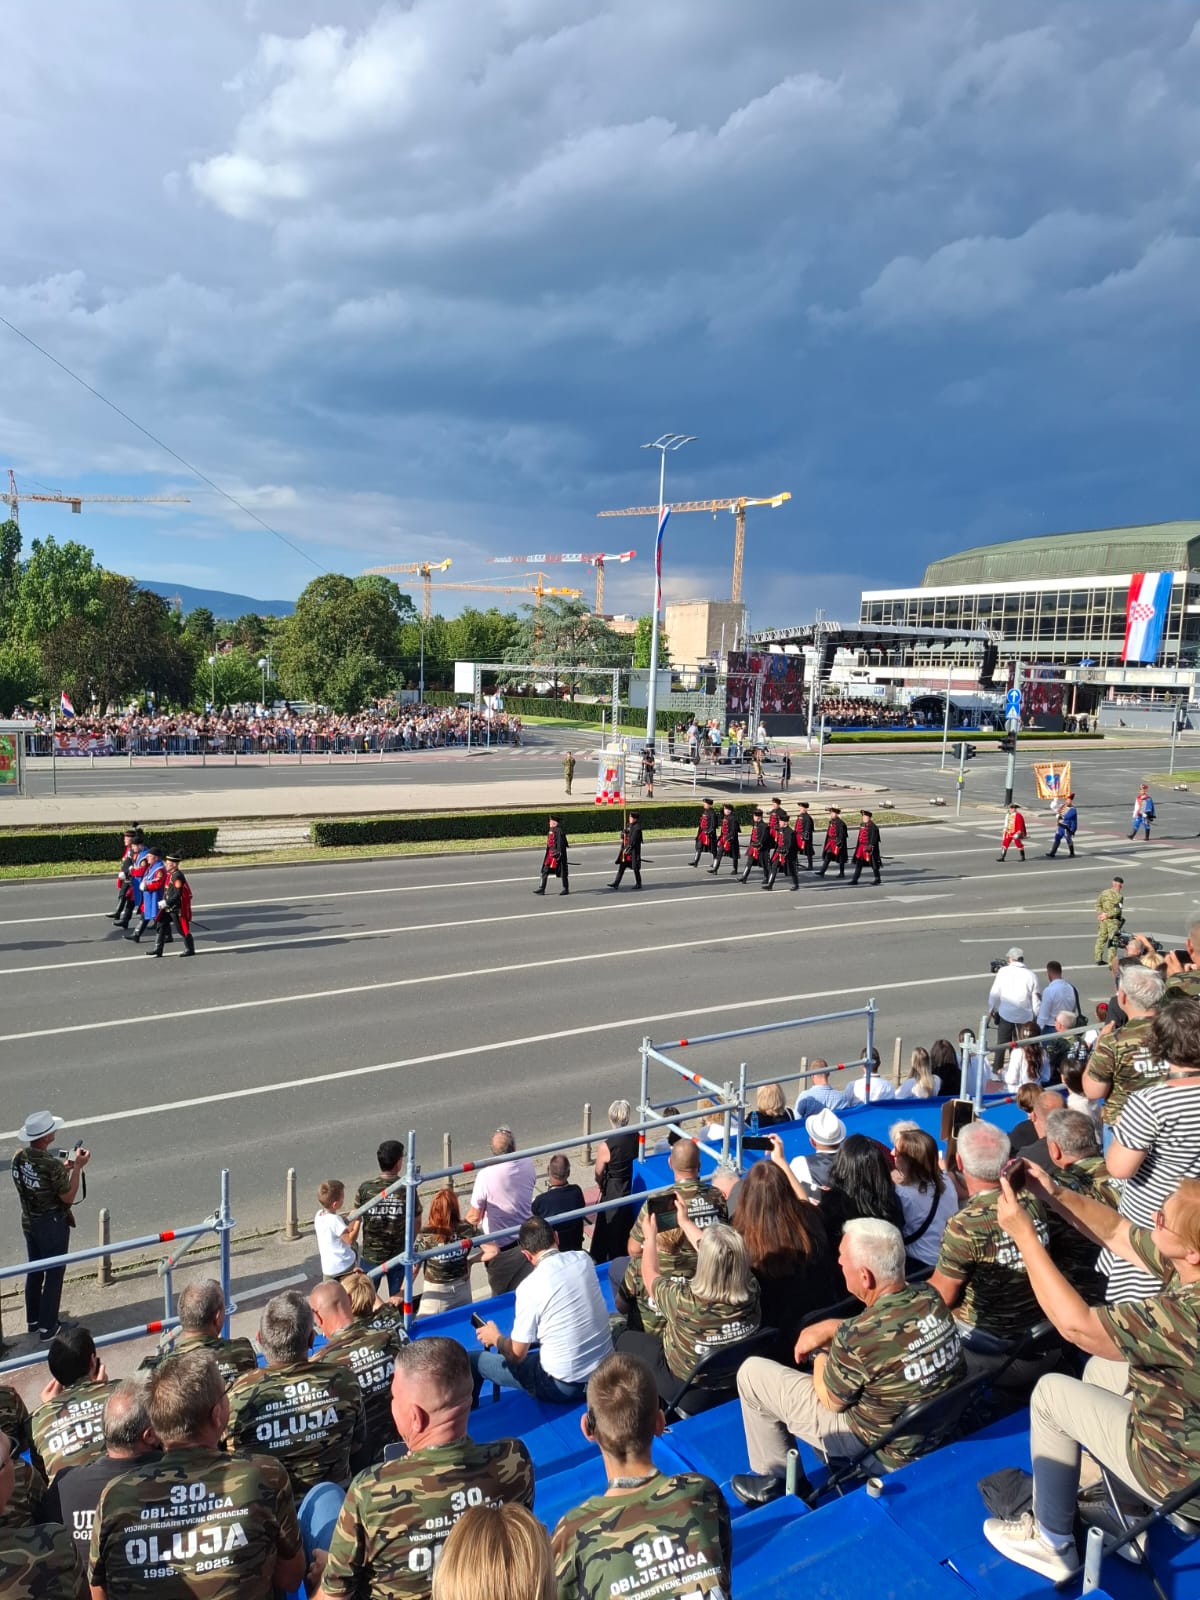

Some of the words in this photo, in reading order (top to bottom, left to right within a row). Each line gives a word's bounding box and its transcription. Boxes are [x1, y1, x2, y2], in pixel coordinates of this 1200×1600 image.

[695, 1215, 719, 1228] UJA
[917, 1314, 941, 1334] 30.
[349, 1346, 375, 1362] 30.
[358, 1361, 395, 1388] UJA
[265, 1390, 330, 1411] OBLJETNICA
[284, 1381, 317, 1398] 30.
[51, 1404, 104, 1428] OBLJETNIC
[256, 1407, 339, 1441] OLUJA
[170, 1482, 216, 1504] 30.
[450, 1487, 491, 1511] 30.
[140, 1496, 234, 1520] OBLJETNICA
[125, 1522, 249, 1565] OLUJA
[632, 1535, 685, 1568] 30.
[143, 1566, 179, 1578] 1995.
[196, 1556, 234, 1572] 2025.
[610, 1551, 708, 1596] OBLJETNICA
